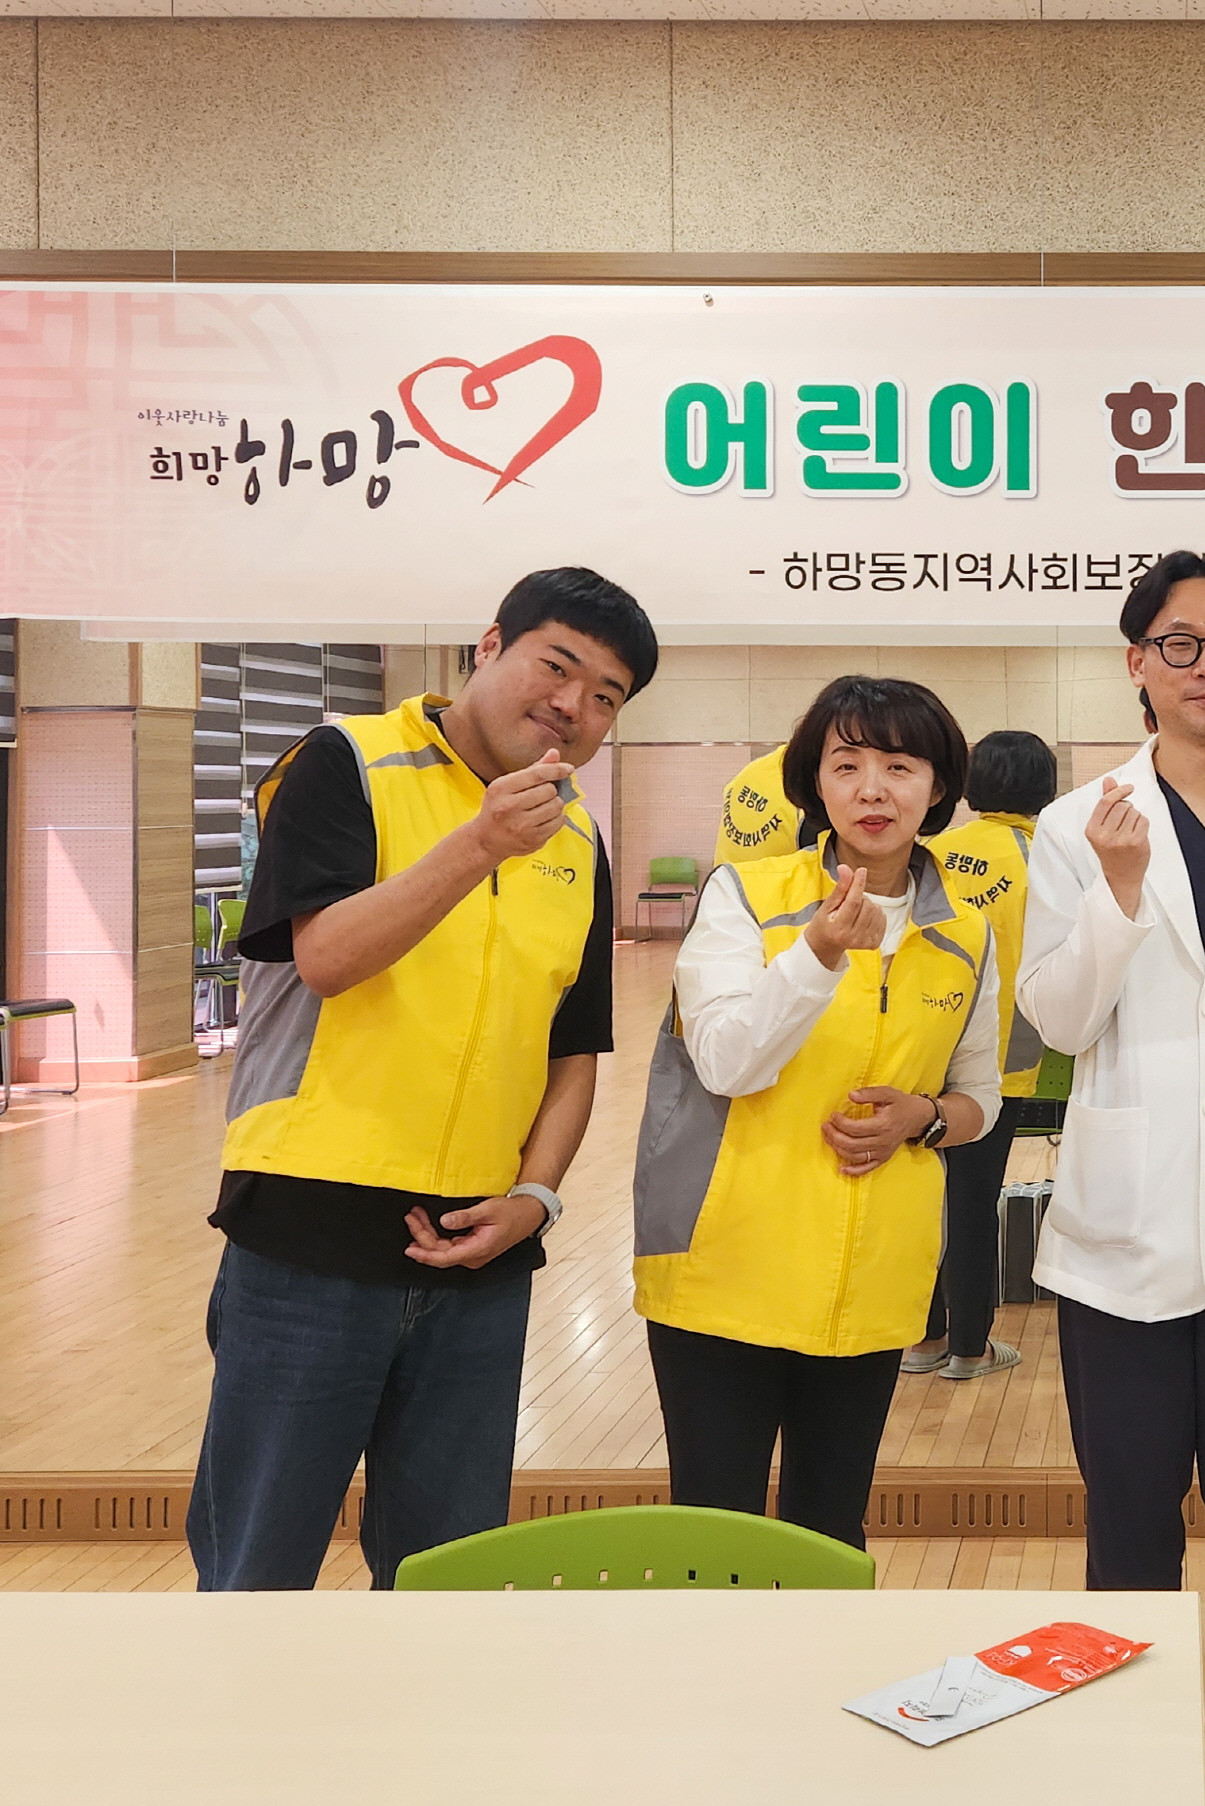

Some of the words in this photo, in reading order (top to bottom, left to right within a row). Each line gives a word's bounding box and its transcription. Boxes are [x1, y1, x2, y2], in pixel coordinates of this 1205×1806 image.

[137, 408, 230, 428] 이웃사랑나눔
[149, 445, 230, 486] 희망
[234, 409, 421, 510] 하망
[662, 378, 1034, 494] 어린이
